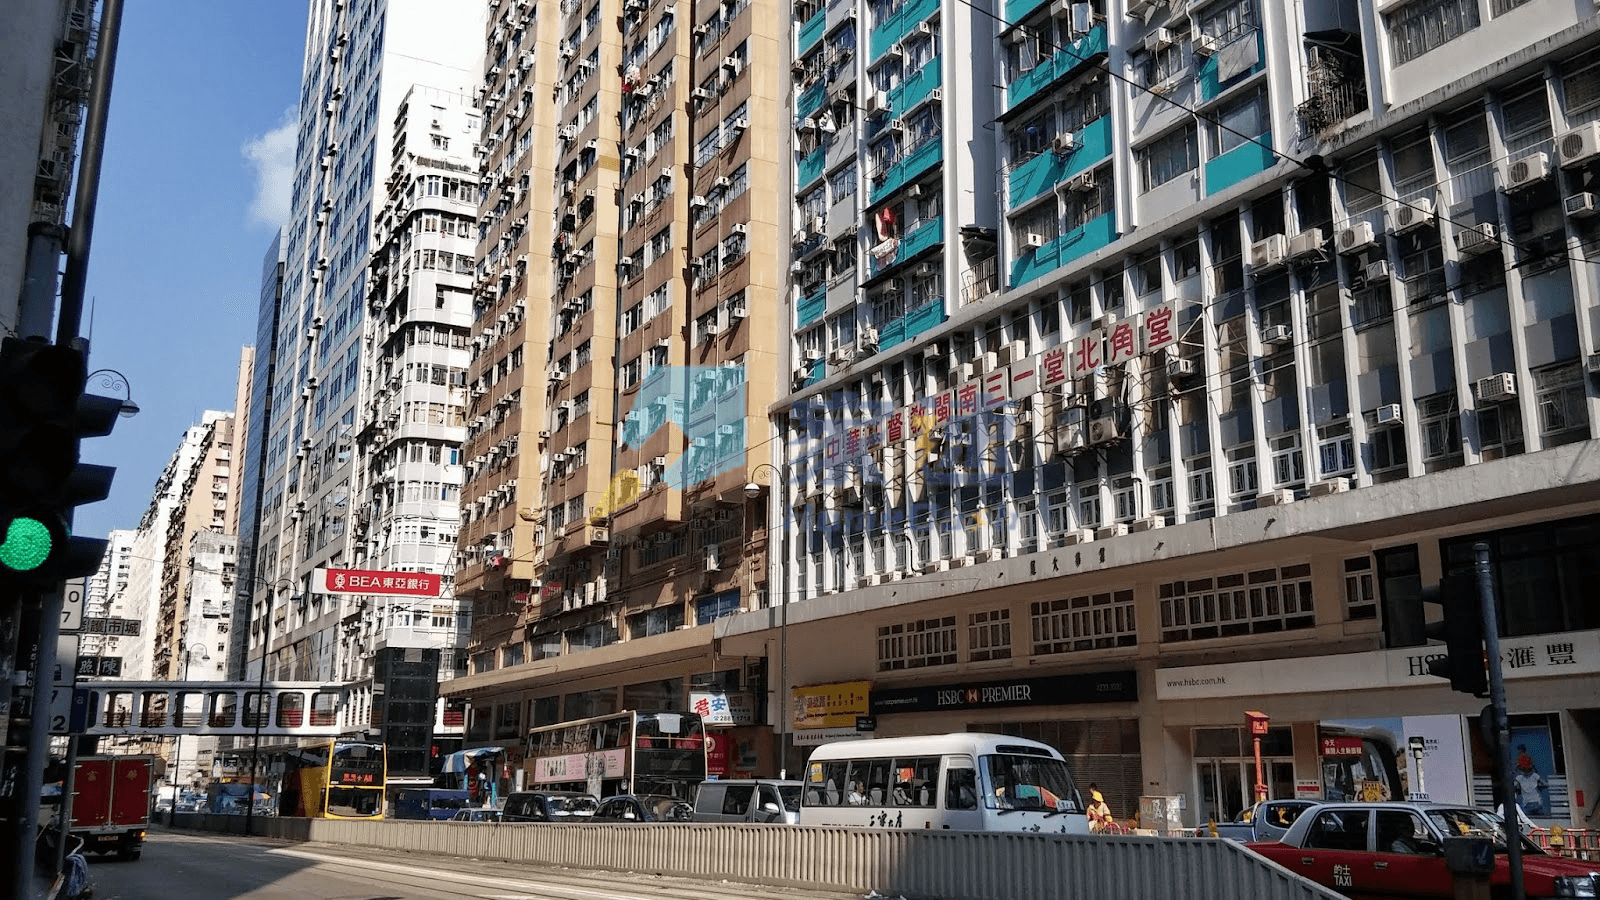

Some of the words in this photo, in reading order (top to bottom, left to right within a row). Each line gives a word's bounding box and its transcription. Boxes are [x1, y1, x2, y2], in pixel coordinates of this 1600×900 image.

[349, 575, 381, 588] BEA
[383, 577, 430, 591] 東亞銀行
[1166, 676, 1226, 687] www.hsbc.com.hk
[937, 688, 965, 706] HSBC
[982, 684, 1032, 704] PREMIER
[1333, 864, 1351, 875] 的士
[1334, 875, 1352, 886] TAXI
